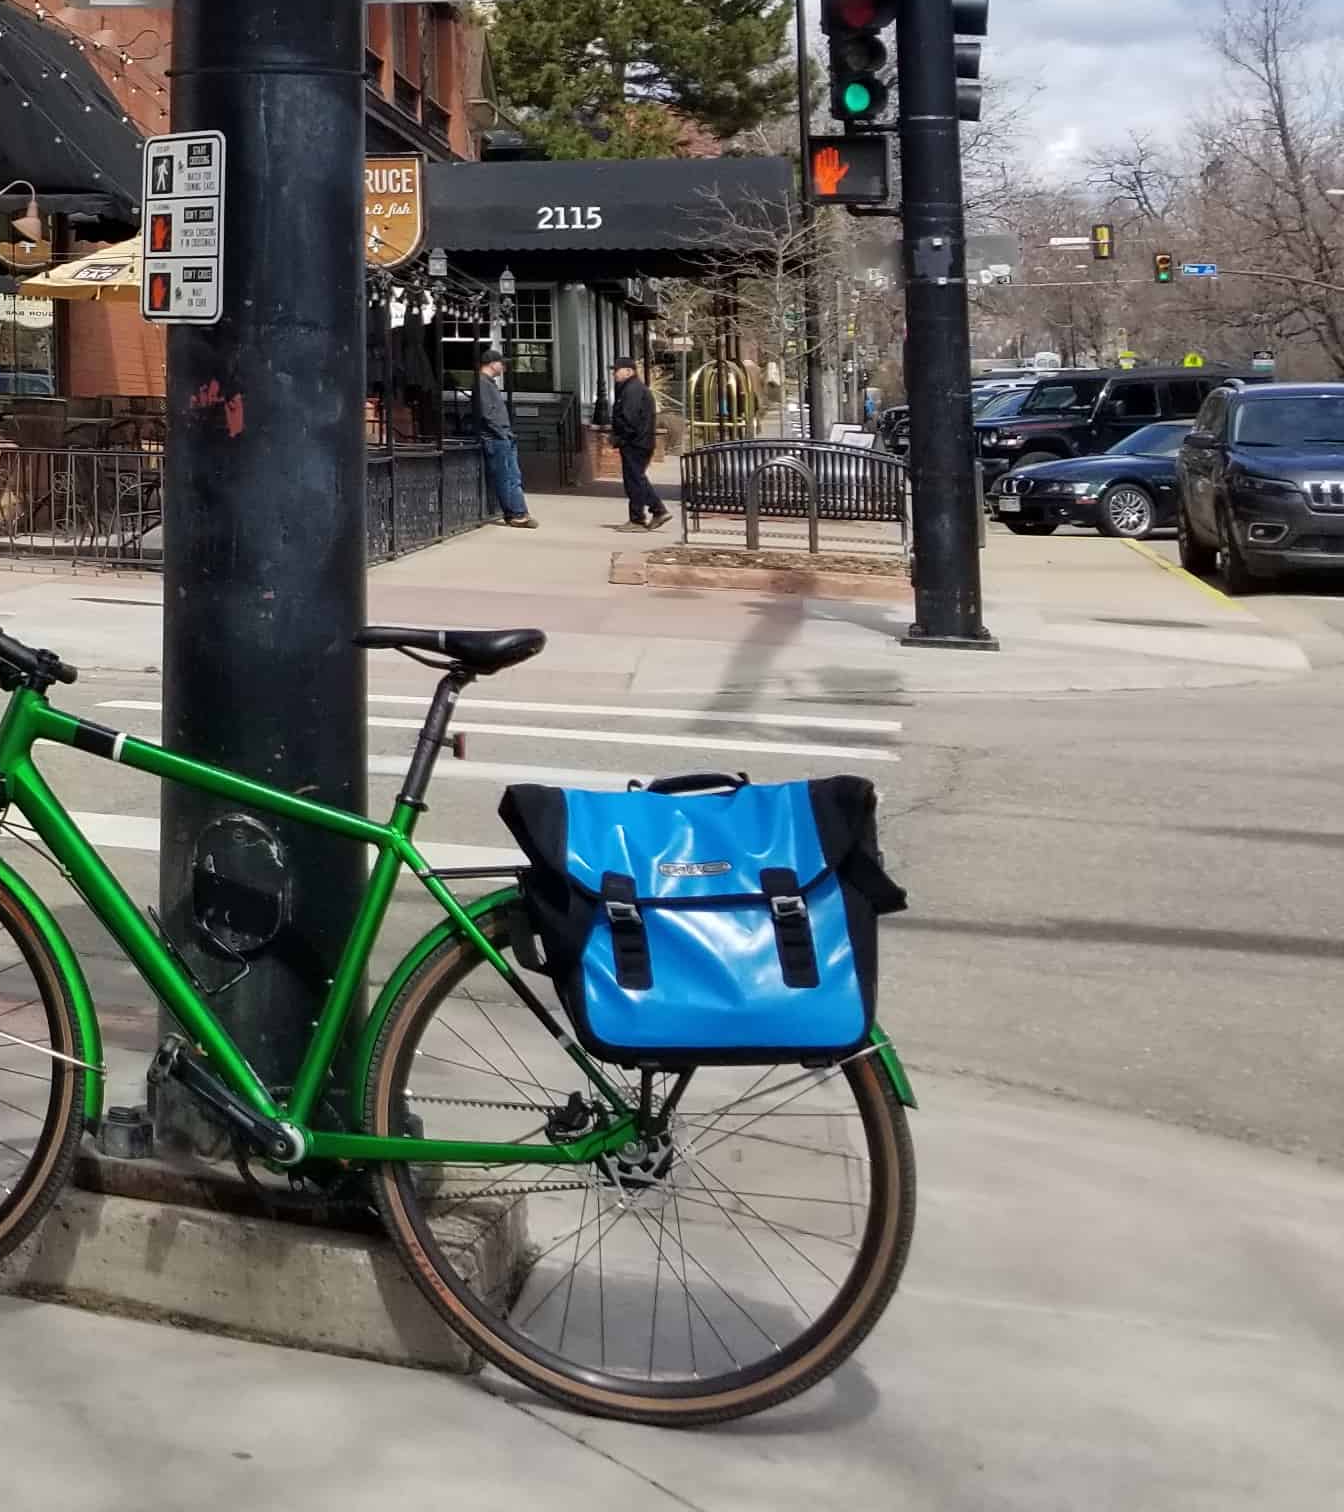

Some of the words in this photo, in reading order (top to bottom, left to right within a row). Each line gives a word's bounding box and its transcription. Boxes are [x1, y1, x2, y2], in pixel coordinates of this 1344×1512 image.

[365, 168, 414, 194] RUCE
[385, 201, 412, 218] fish
[537, 206, 603, 230] 2115
